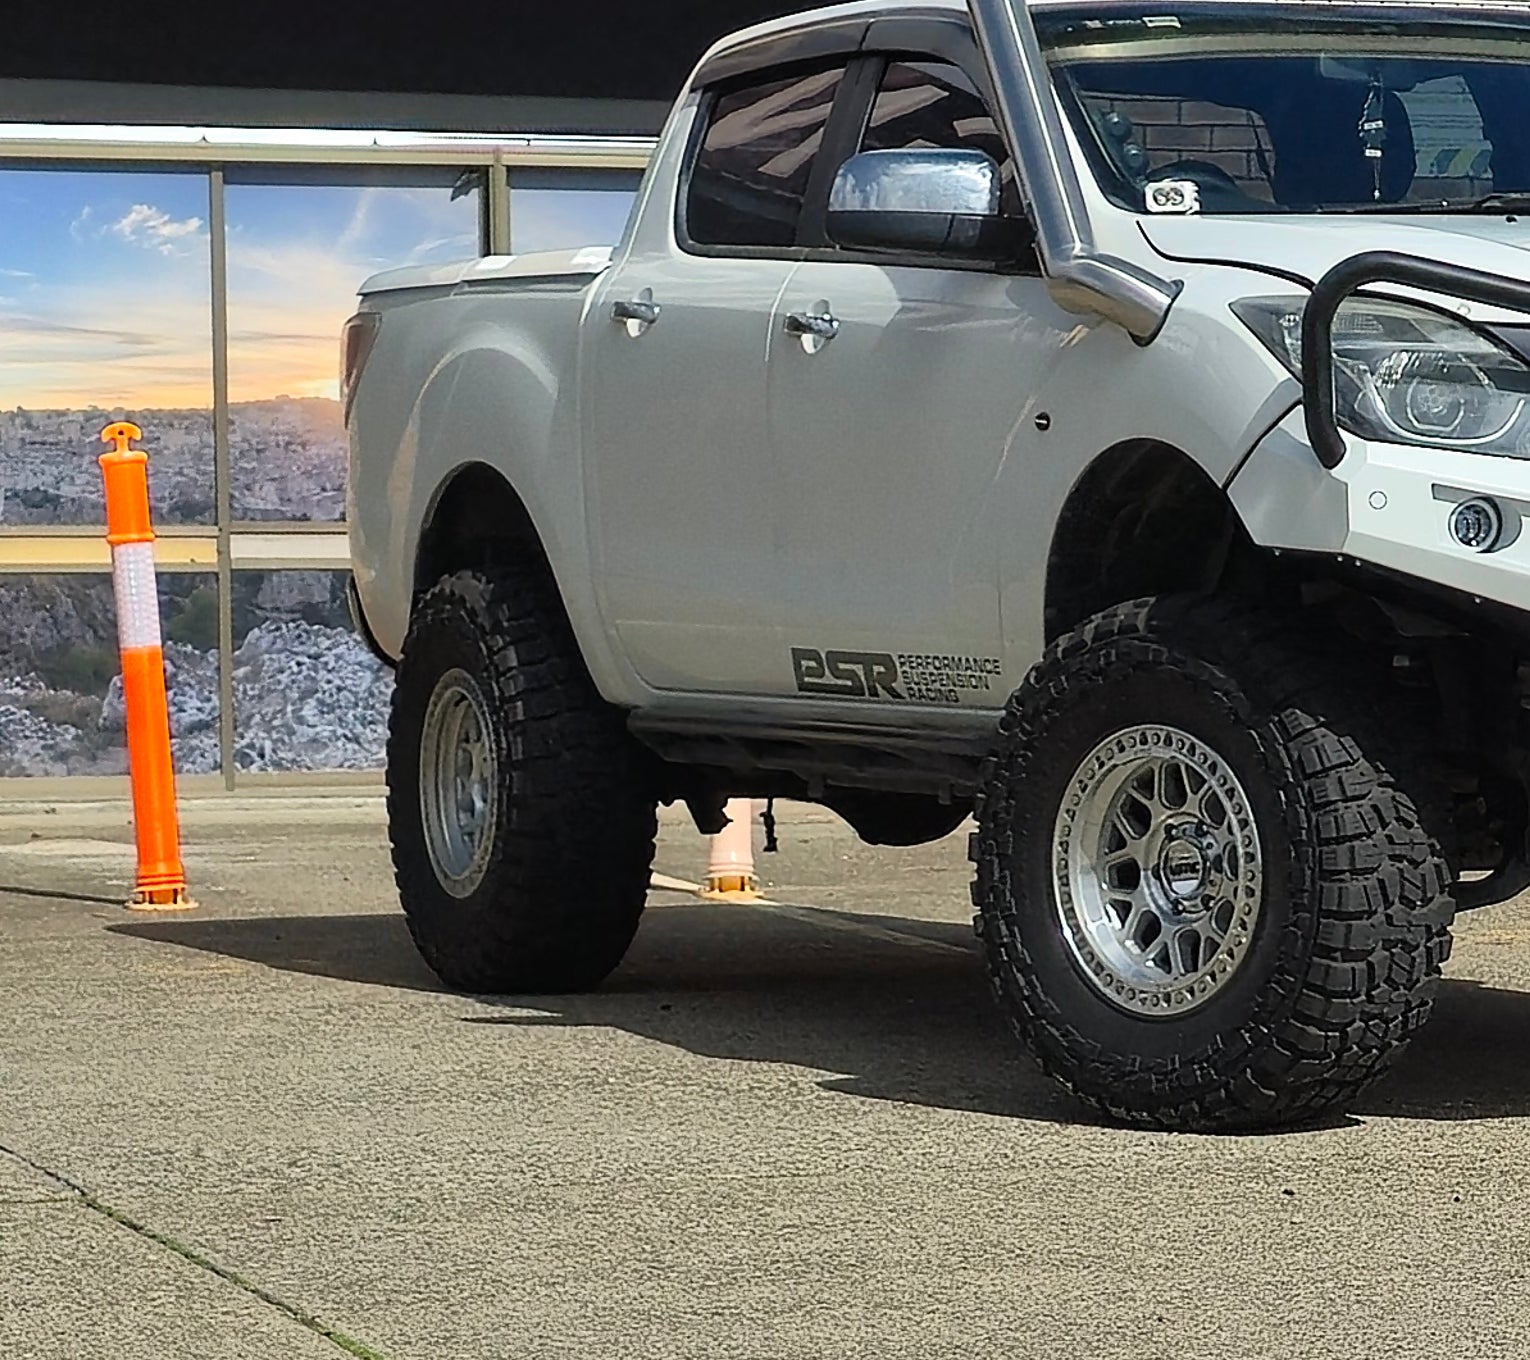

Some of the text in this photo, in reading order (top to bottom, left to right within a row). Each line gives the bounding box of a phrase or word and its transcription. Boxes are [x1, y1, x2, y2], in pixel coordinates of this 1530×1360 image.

[897, 653, 1001, 676] PERFORMANCE
[901, 670, 991, 690] SUSPENSION
[906, 686, 960, 703] RACING
